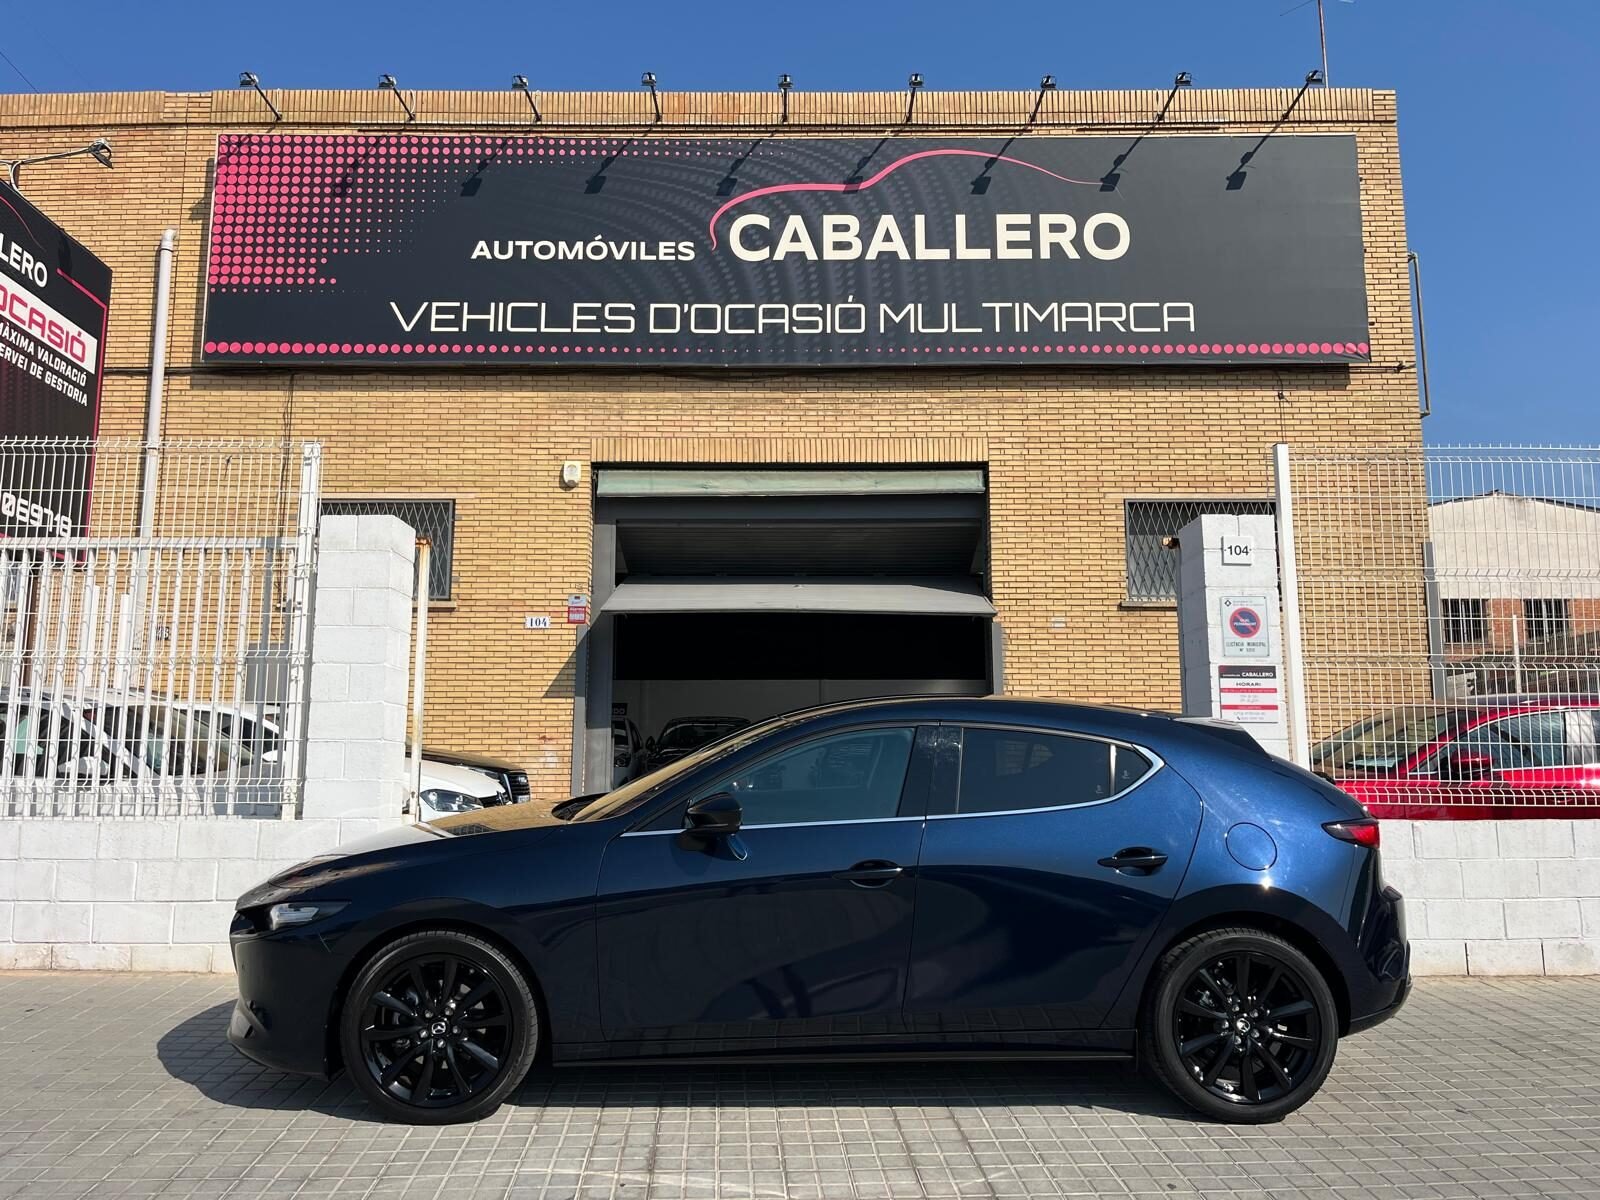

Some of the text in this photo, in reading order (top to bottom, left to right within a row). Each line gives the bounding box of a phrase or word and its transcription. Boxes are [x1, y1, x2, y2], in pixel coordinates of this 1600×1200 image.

[470, 212, 1131, 262] AUTOMÓVILES CABALLERO
[389, 301, 636, 334] VEHICLES
[649, 294, 866, 334] D'OCASIÓ
[29, 361, 44, 380] DE
[44, 370, 88, 406] GESTORIA
[37, 346, 87, 387] VALORACIÓ
[1227, 545, 1250, 556] 104
[529, 617, 547, 627] 104
